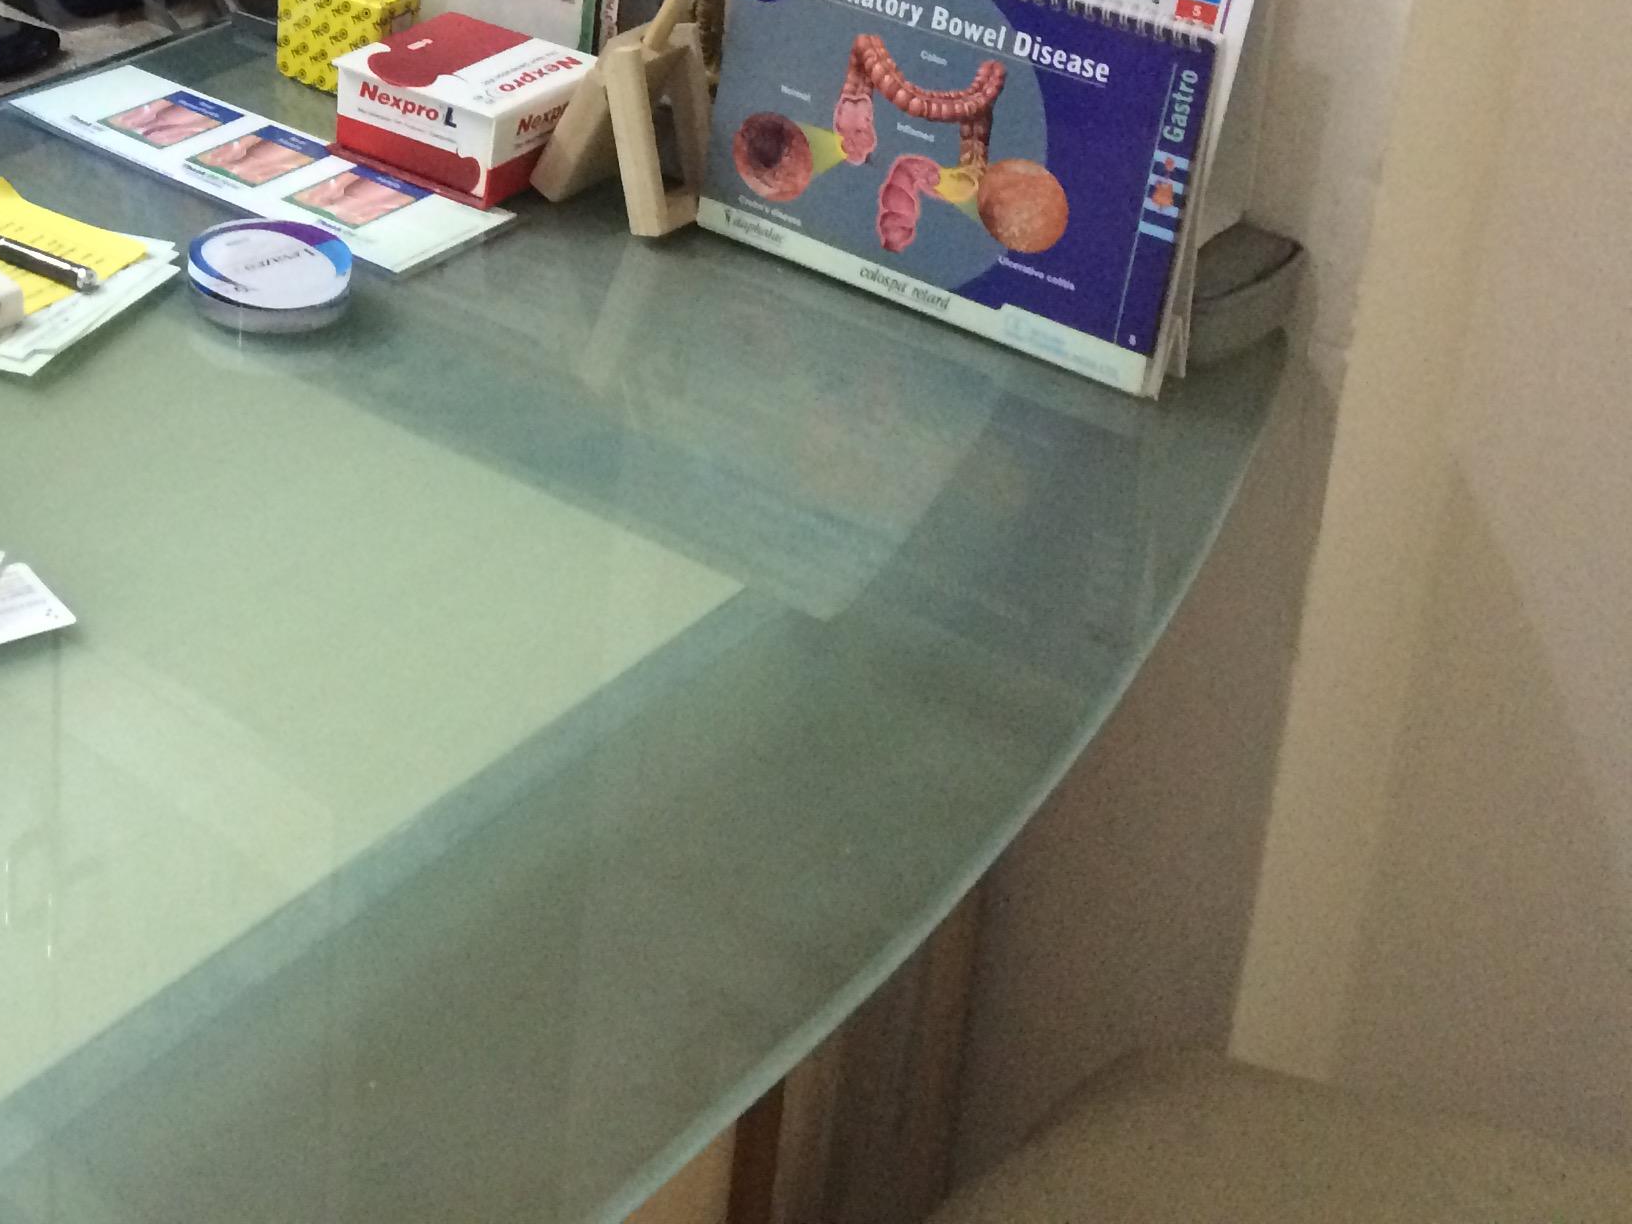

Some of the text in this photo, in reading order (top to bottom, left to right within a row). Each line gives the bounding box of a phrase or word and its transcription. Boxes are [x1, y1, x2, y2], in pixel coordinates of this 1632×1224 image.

[920, 49, 948, 67] Colon
[931, 5, 1008, 51] Bowel
[1013, 31, 1111, 84] Disease
[498, 56, 583, 94] Nexpro
[359, 80, 439, 121] Nexpro
[443, 107, 457, 129] L
[1162, 69, 1199, 143] Gastro
